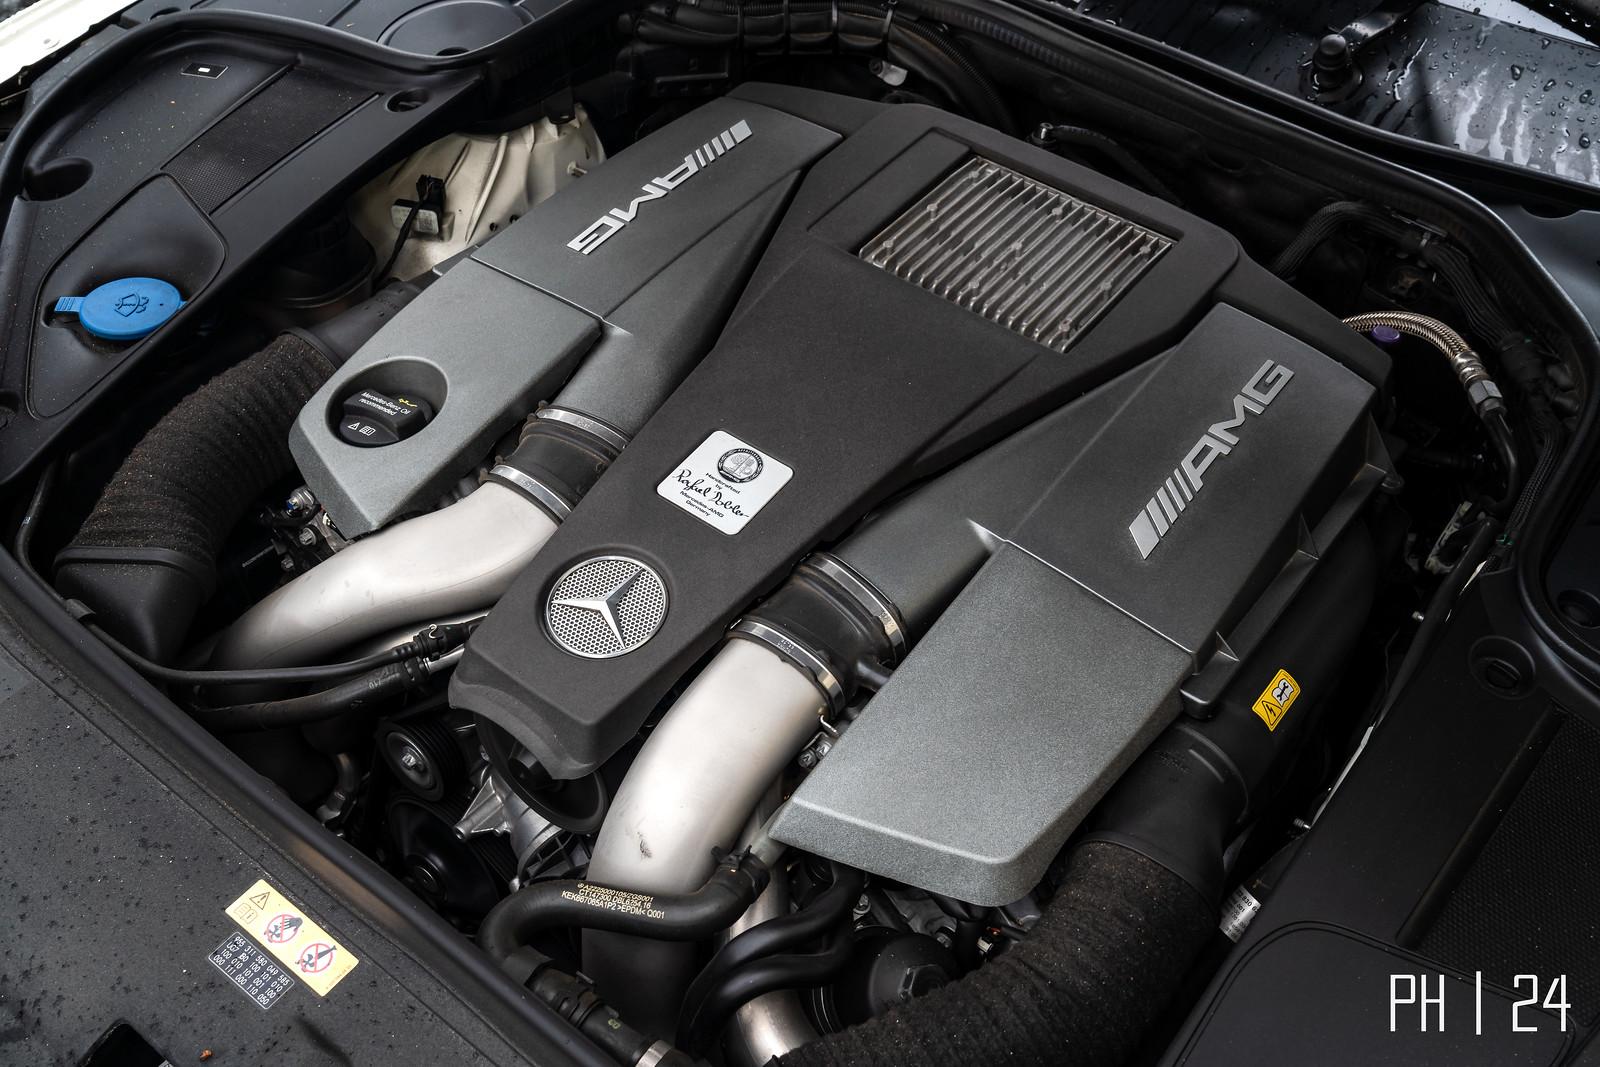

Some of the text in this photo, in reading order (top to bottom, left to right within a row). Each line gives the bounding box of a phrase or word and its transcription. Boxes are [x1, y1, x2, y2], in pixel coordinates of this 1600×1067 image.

[359, 398, 397, 416] recommended
[361, 392, 402, 412] Mercedes-Benz
[706, 472, 740, 494] Handcrafted
[680, 490, 724, 518] Mercedes-AMG
[686, 500, 710, 516] Germany
[234, 936, 245, 947] 955
[244, 945, 255, 956] 311
[267, 965, 278, 975] 049
[214, 955, 270, 1005] 000 111 000 110 050
[221, 949, 276, 998] 100 010 101 001 100
[250, 962, 261, 972] 100
[261, 971, 271, 982] 101
[271, 982, 282, 992] 010
